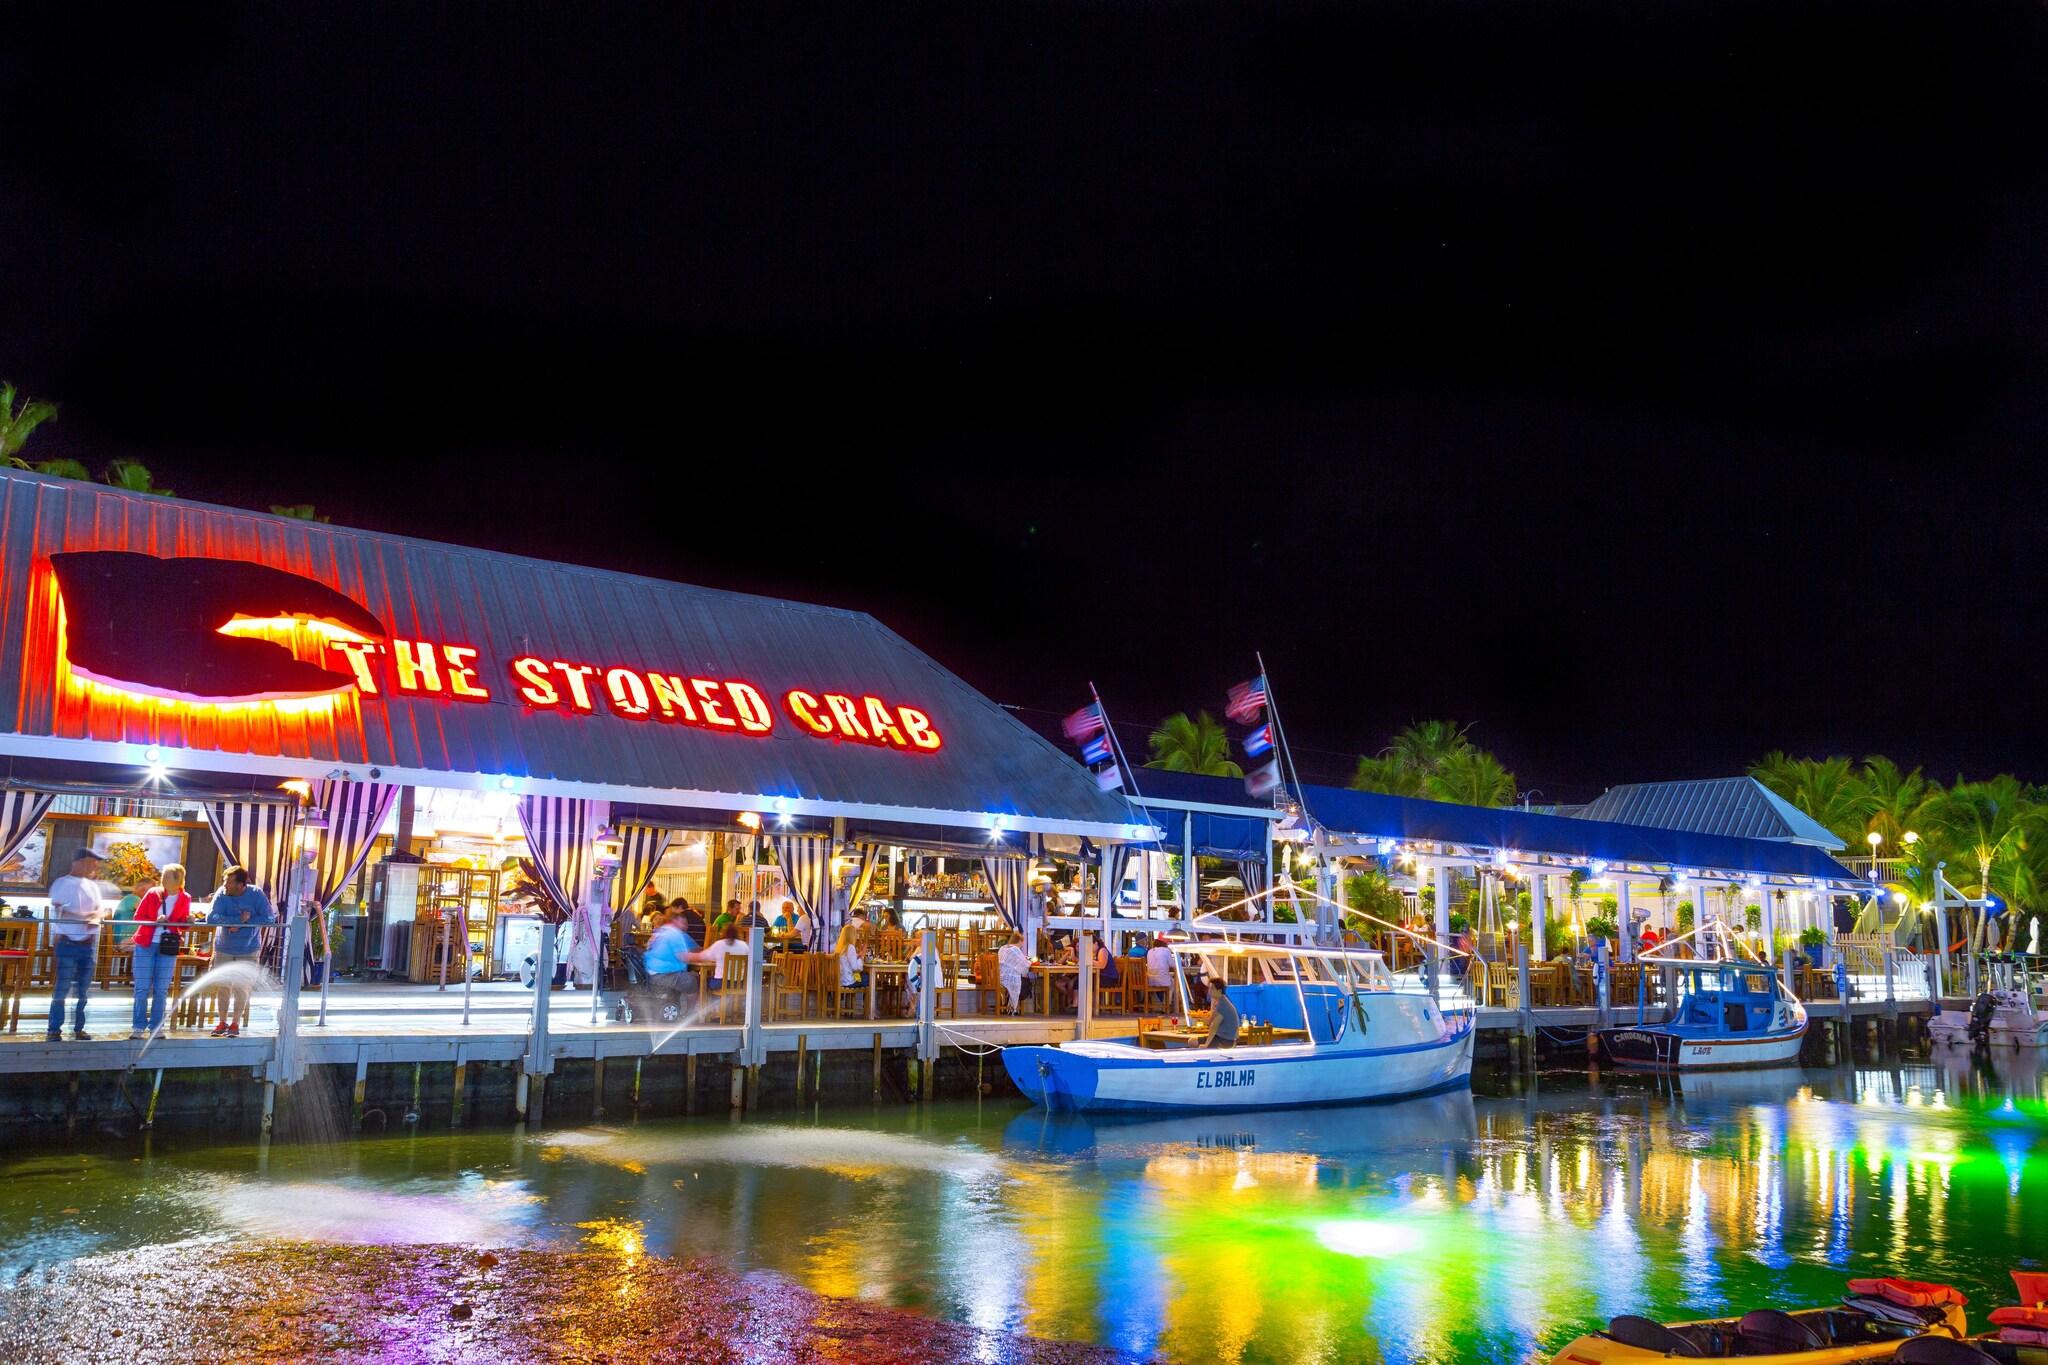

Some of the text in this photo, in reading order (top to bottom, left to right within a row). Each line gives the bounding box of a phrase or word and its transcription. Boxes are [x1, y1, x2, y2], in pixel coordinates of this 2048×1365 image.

[328, 638, 942, 752] THE STONED CRAB
[1197, 1069, 1255, 1088] EL BALMA
